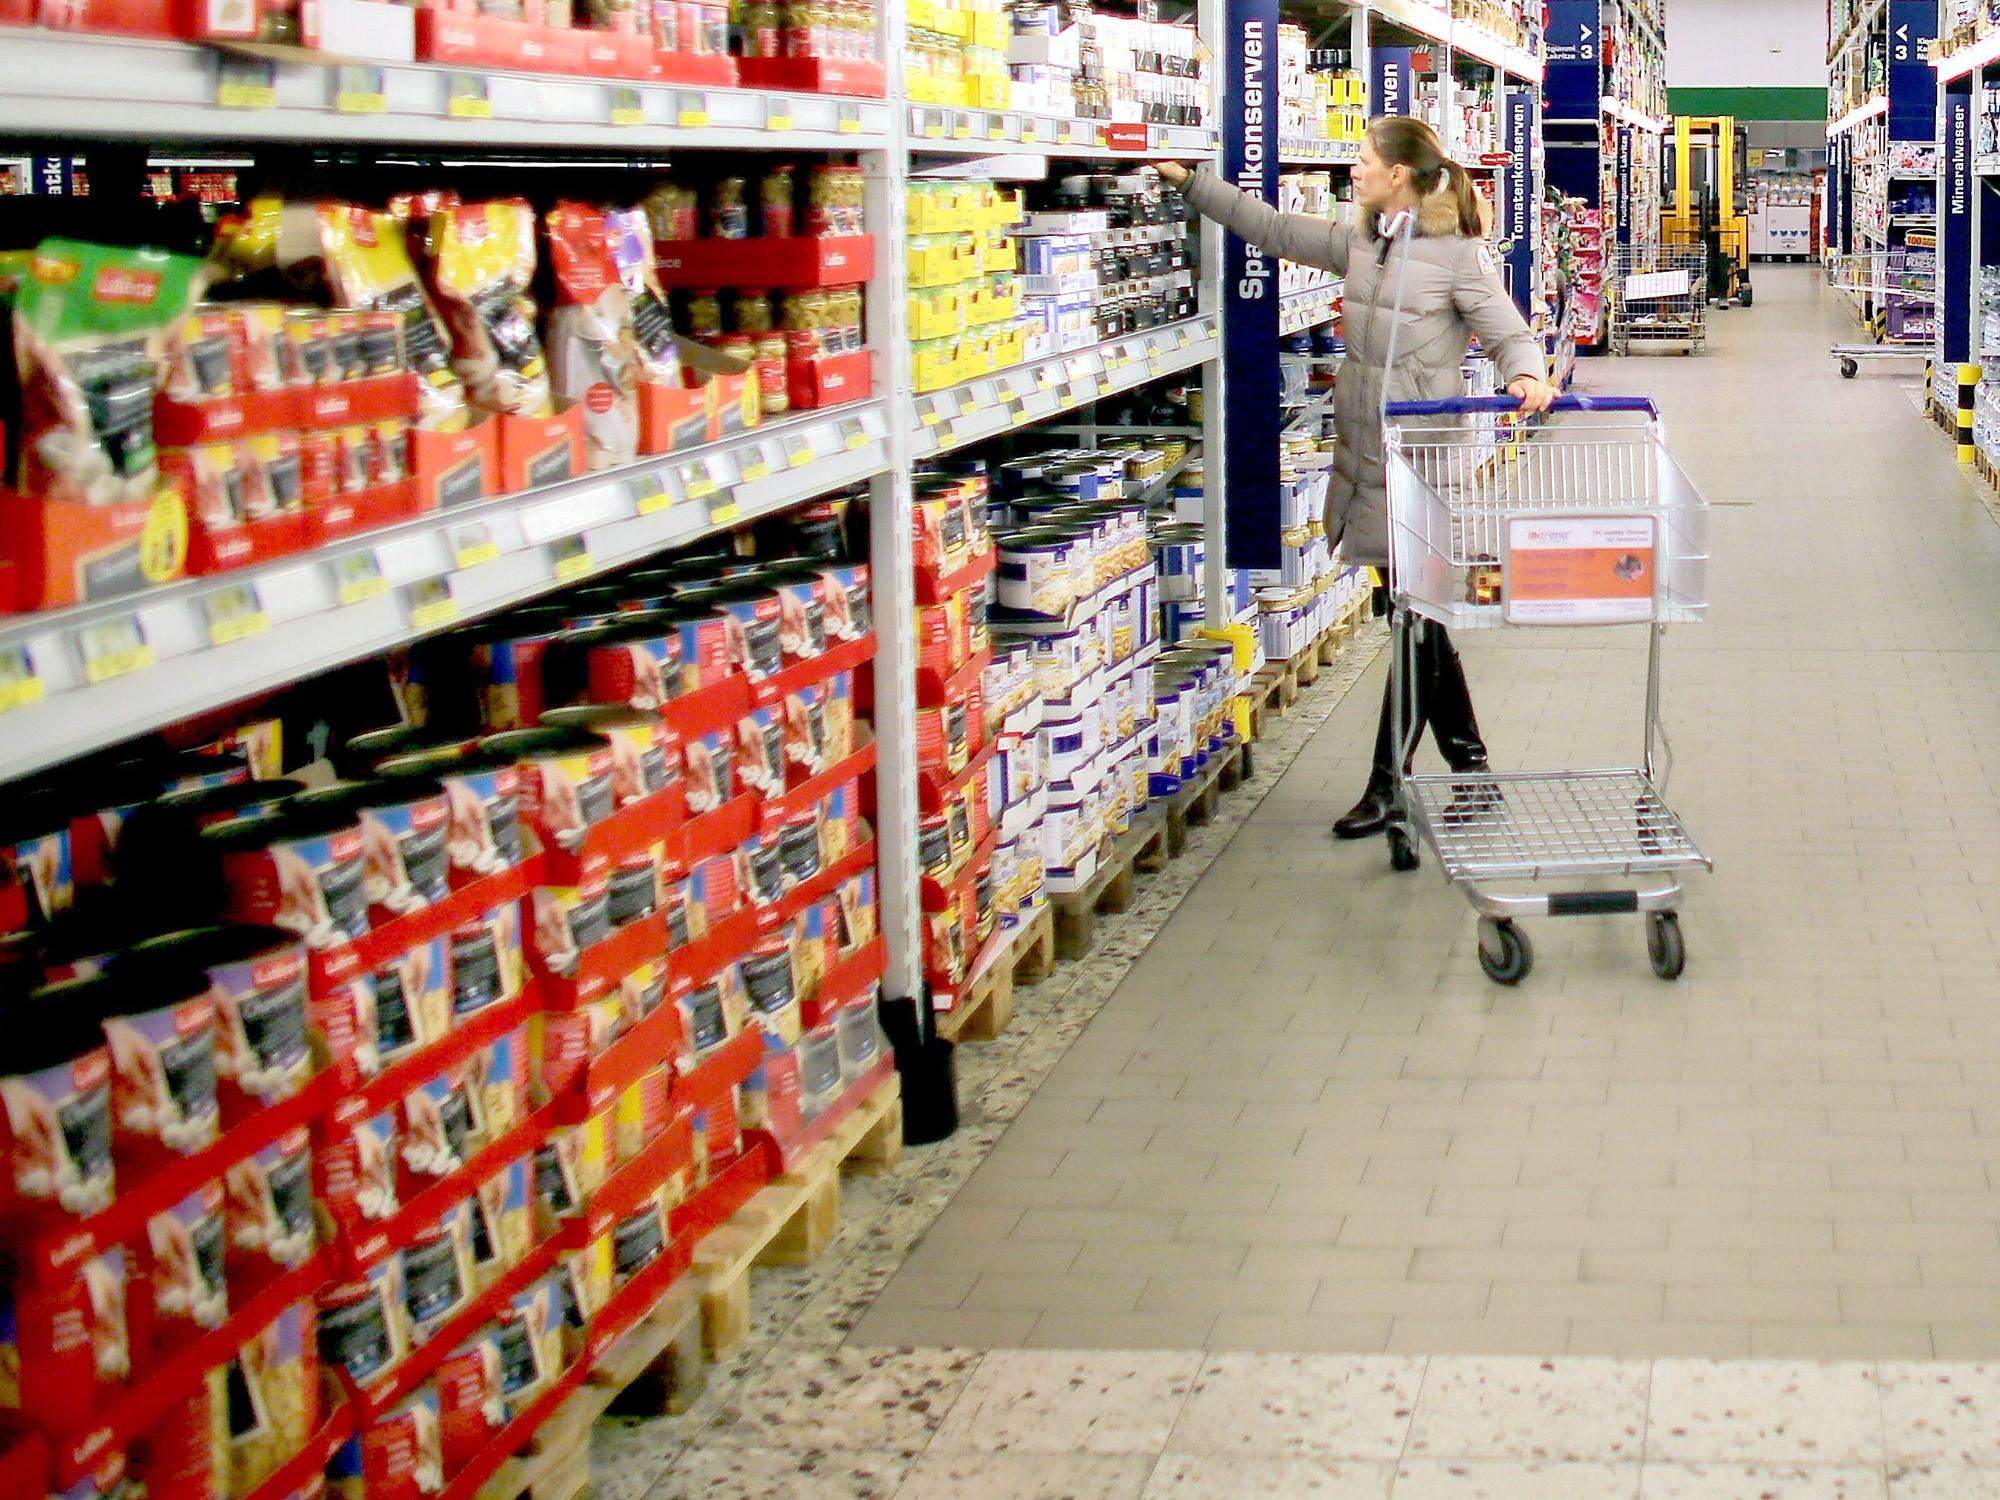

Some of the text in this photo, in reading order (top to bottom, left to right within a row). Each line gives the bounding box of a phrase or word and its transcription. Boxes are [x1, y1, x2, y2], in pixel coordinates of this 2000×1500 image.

[1581, 45, 1593, 59] 3
[1895, 45, 1908, 60] 3
[1239, 21, 1269, 299] Spaelkonserven
[1511, 104, 1524, 241] Tomatenkonserven
[1952, 104, 1964, 214] Mineralwasser
